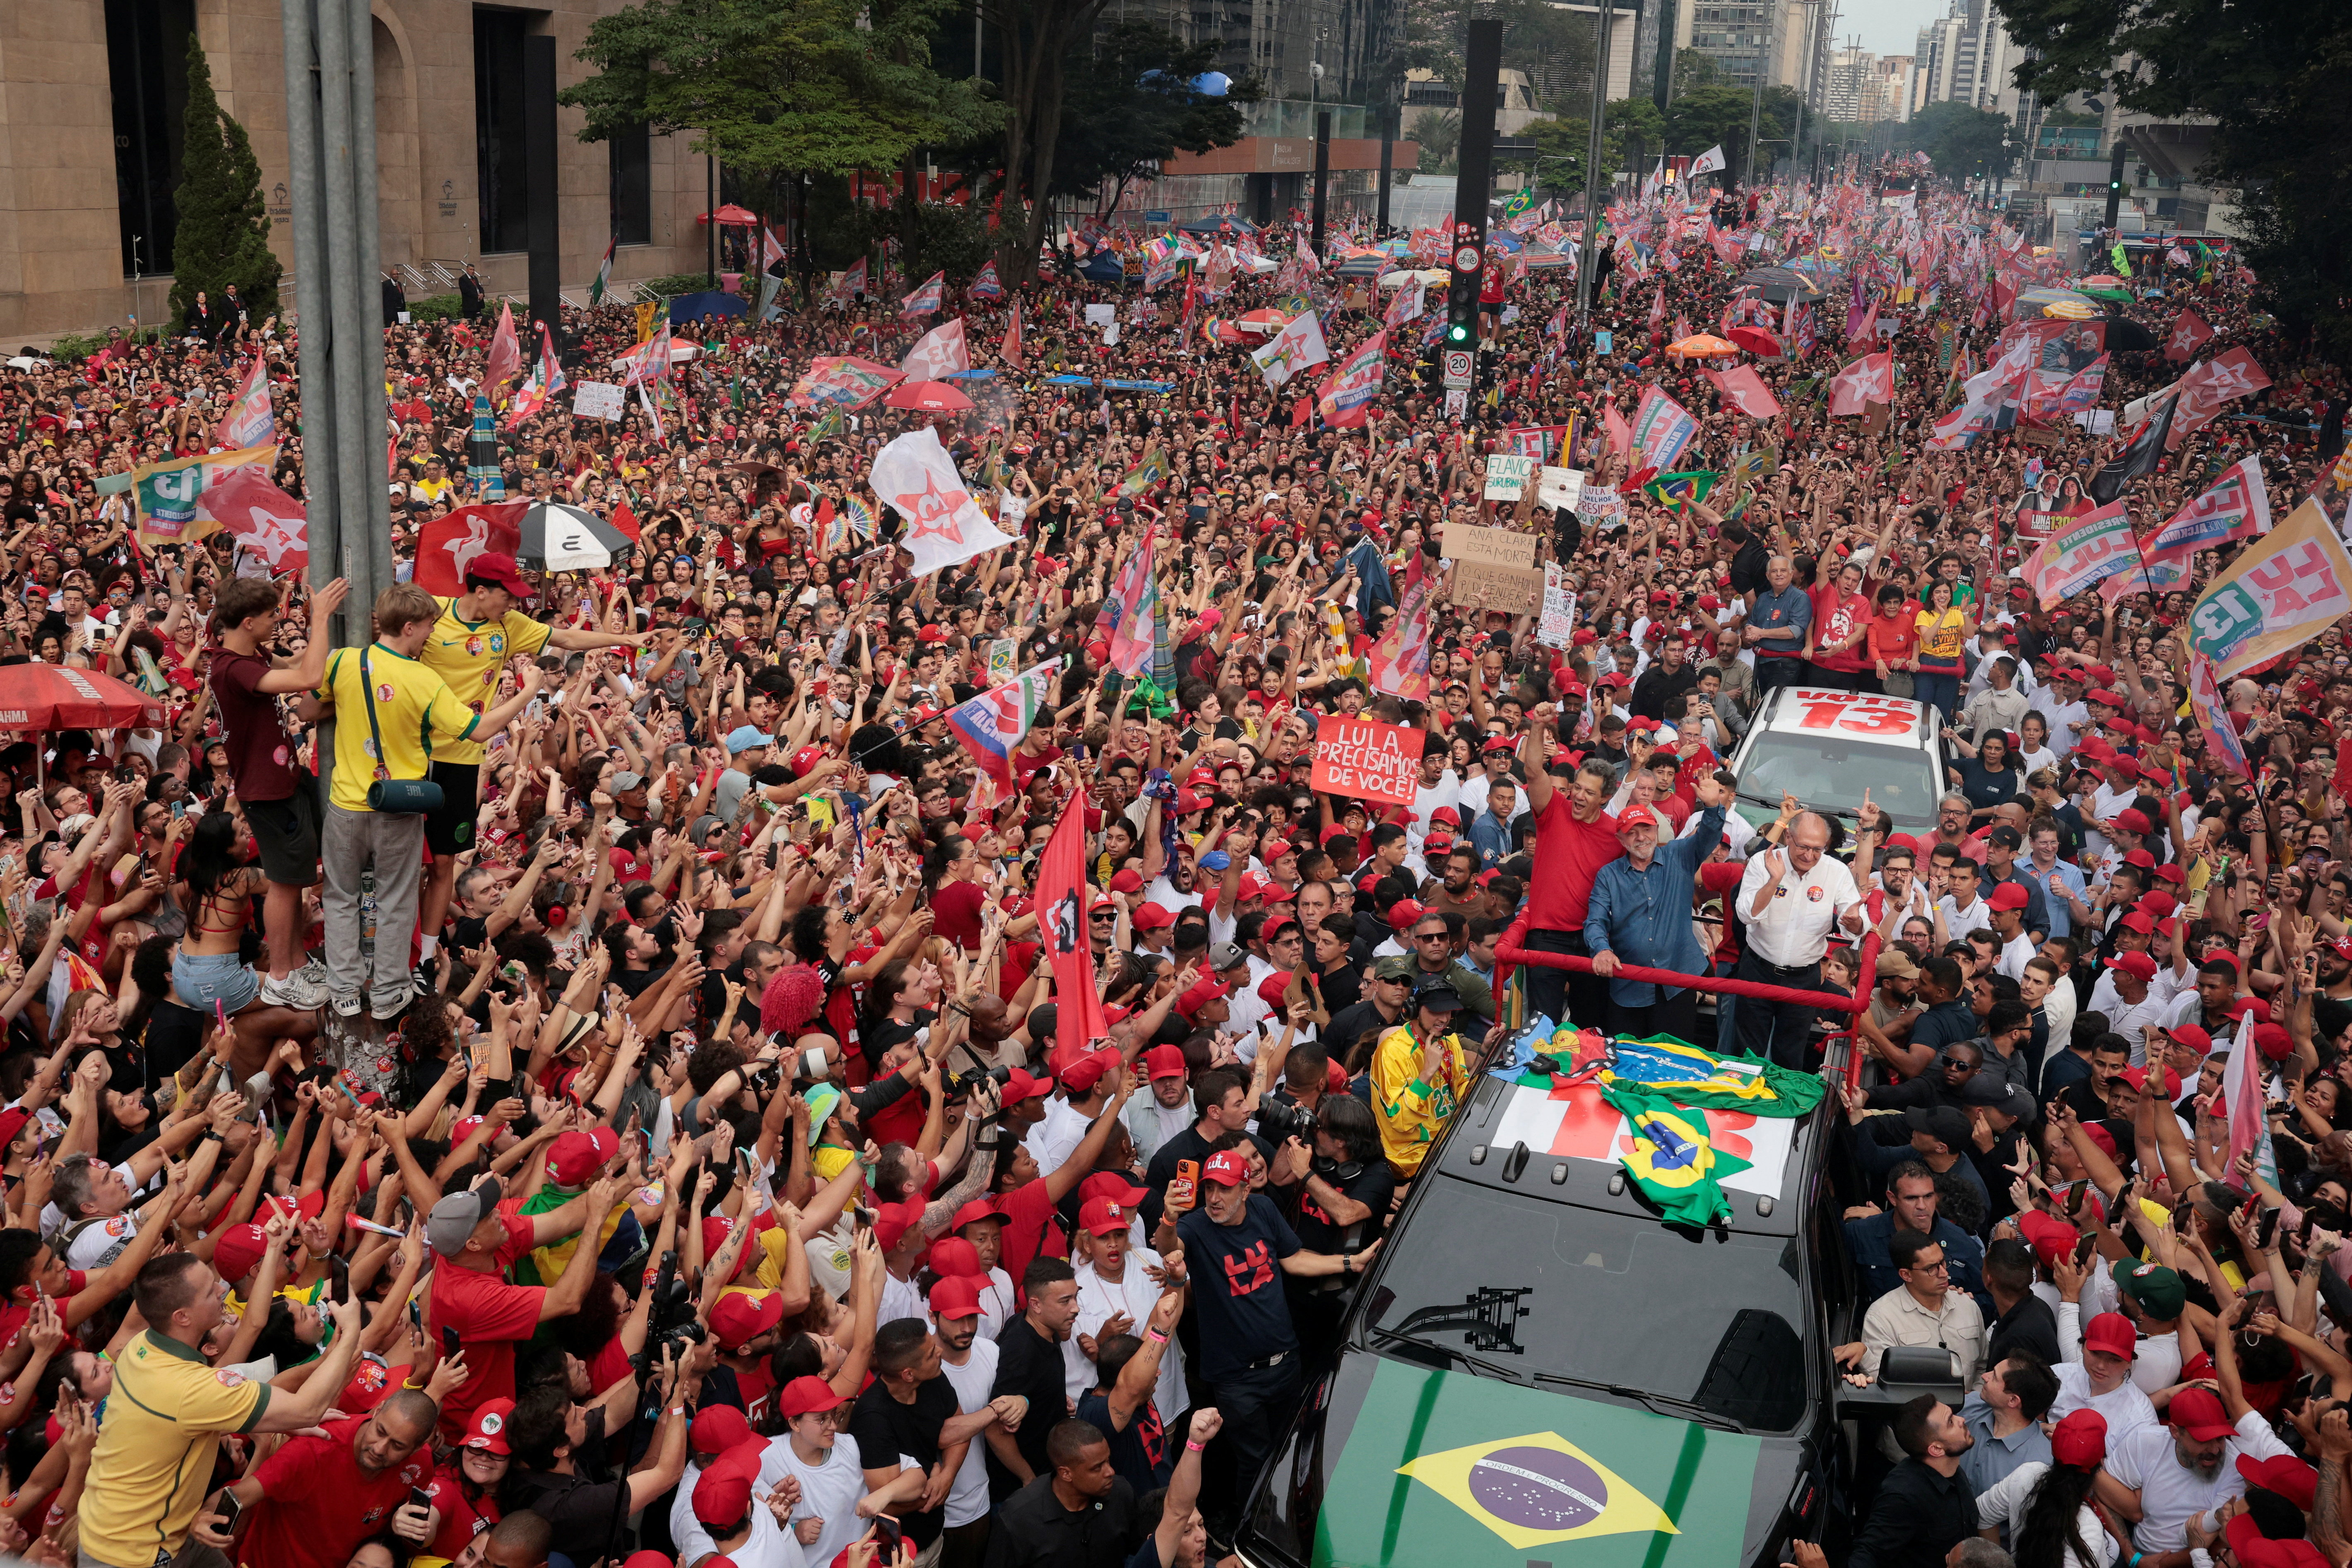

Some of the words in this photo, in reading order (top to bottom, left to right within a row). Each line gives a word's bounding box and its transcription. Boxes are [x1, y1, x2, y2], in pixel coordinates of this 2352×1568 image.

[1458, 224, 1468, 233] 13
[1122, 263, 1144, 275] PSOL
[536, 321, 544, 330] 13
[1452, 358, 1466, 369] 20
[597, 385, 614, 394] FERE
[1584, 487, 1604, 495] LULA
[802, 508, 812, 522] 13
[2032, 515, 2051, 525] LUNA
[1469, 528, 1493, 541] ANA
[1499, 534, 1533, 548] CLARA
[1466, 541, 1492, 556] ESTÁ
[1493, 546, 1532, 564] MORTA
[1461, 565, 1471, 576] O
[1474, 568, 1495, 582] QUE
[1957, 573, 1971, 582] Enem
[1547, 589, 1556, 597] NÃO
[1555, 591, 1560, 599] É
[1461, 593, 1526, 613] ASASSINO?
[1545, 596, 1557, 606] FALTA
[1543, 611, 1548, 620] É
[1548, 613, 1563, 625] FALTA
[1562, 617, 1570, 627] DE
[993, 640, 1011, 649] PATRIOTA
[1938, 633, 1959, 645] VIVA!
[53, 668, 102, 699] BRAHMA
[1797, 691, 1912, 709] VOTE
[1800, 702, 1917, 735] 13
[1338, 724, 1399, 755] LULA,
[801, 752, 811, 763] LULA
[1328, 766, 1354, 787] DE
[1358, 770, 1413, 801] VOCÊ!
[405, 785, 424, 797] JBL
[624, 861, 636, 869] Lula
[1774, 887, 1786, 897] 13
[340, 998, 359, 1009] NIKE
[474, 1054, 490, 1065] ATRAS
[1433, 1083, 1456, 1119] 23
[1207, 1157, 1230, 1171] LULA
[1485, 1460, 1526, 1477] ORDEM
[1533, 1473, 1598, 1509] PROGRESSO
